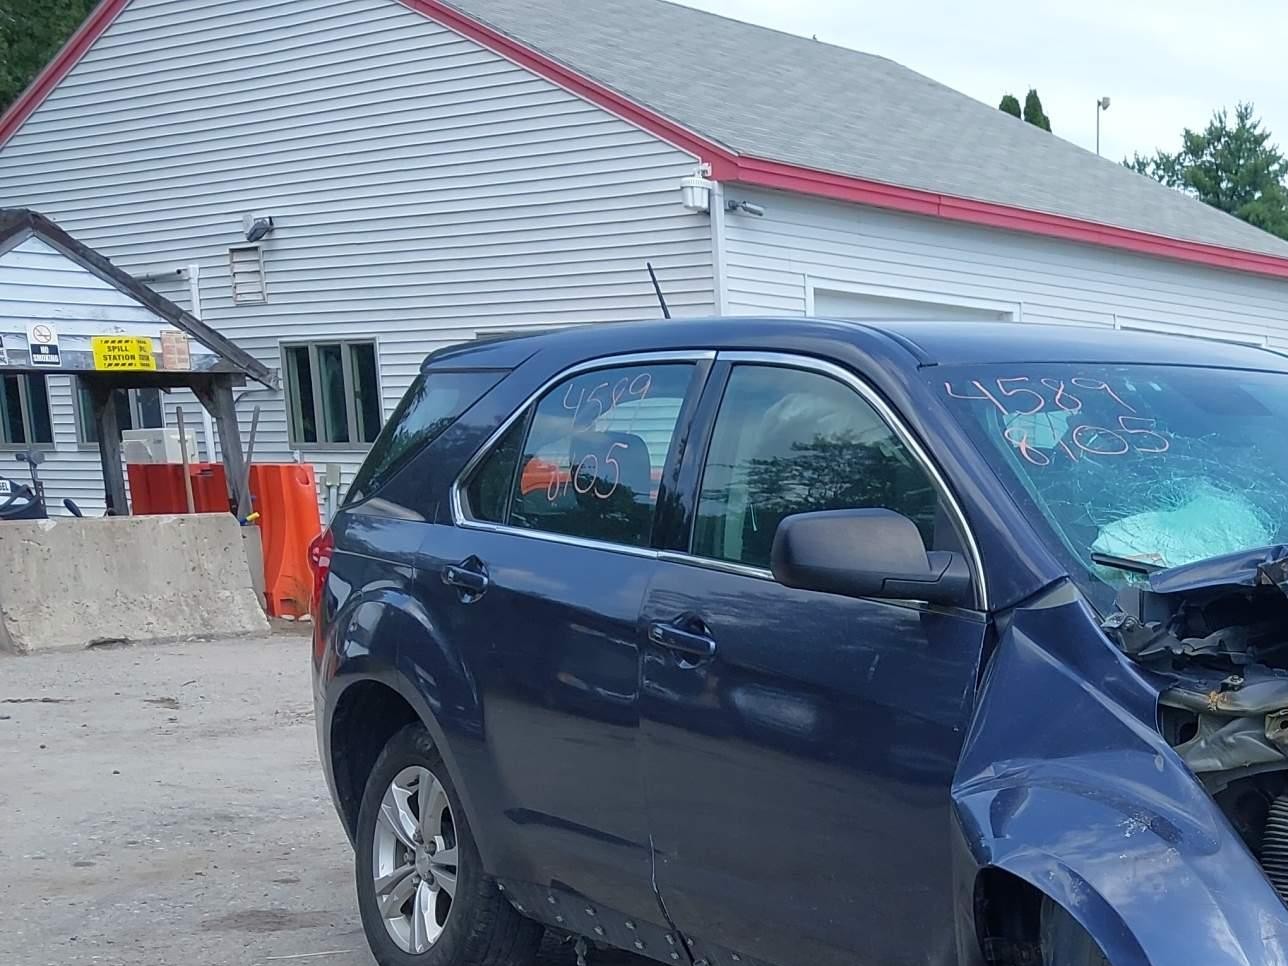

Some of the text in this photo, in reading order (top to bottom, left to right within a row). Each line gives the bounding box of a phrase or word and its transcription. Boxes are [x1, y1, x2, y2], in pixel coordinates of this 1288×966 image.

[107, 345, 129, 353] SPILL
[563, 373, 652, 433] 4589
[944, 377, 1136, 415] 4589
